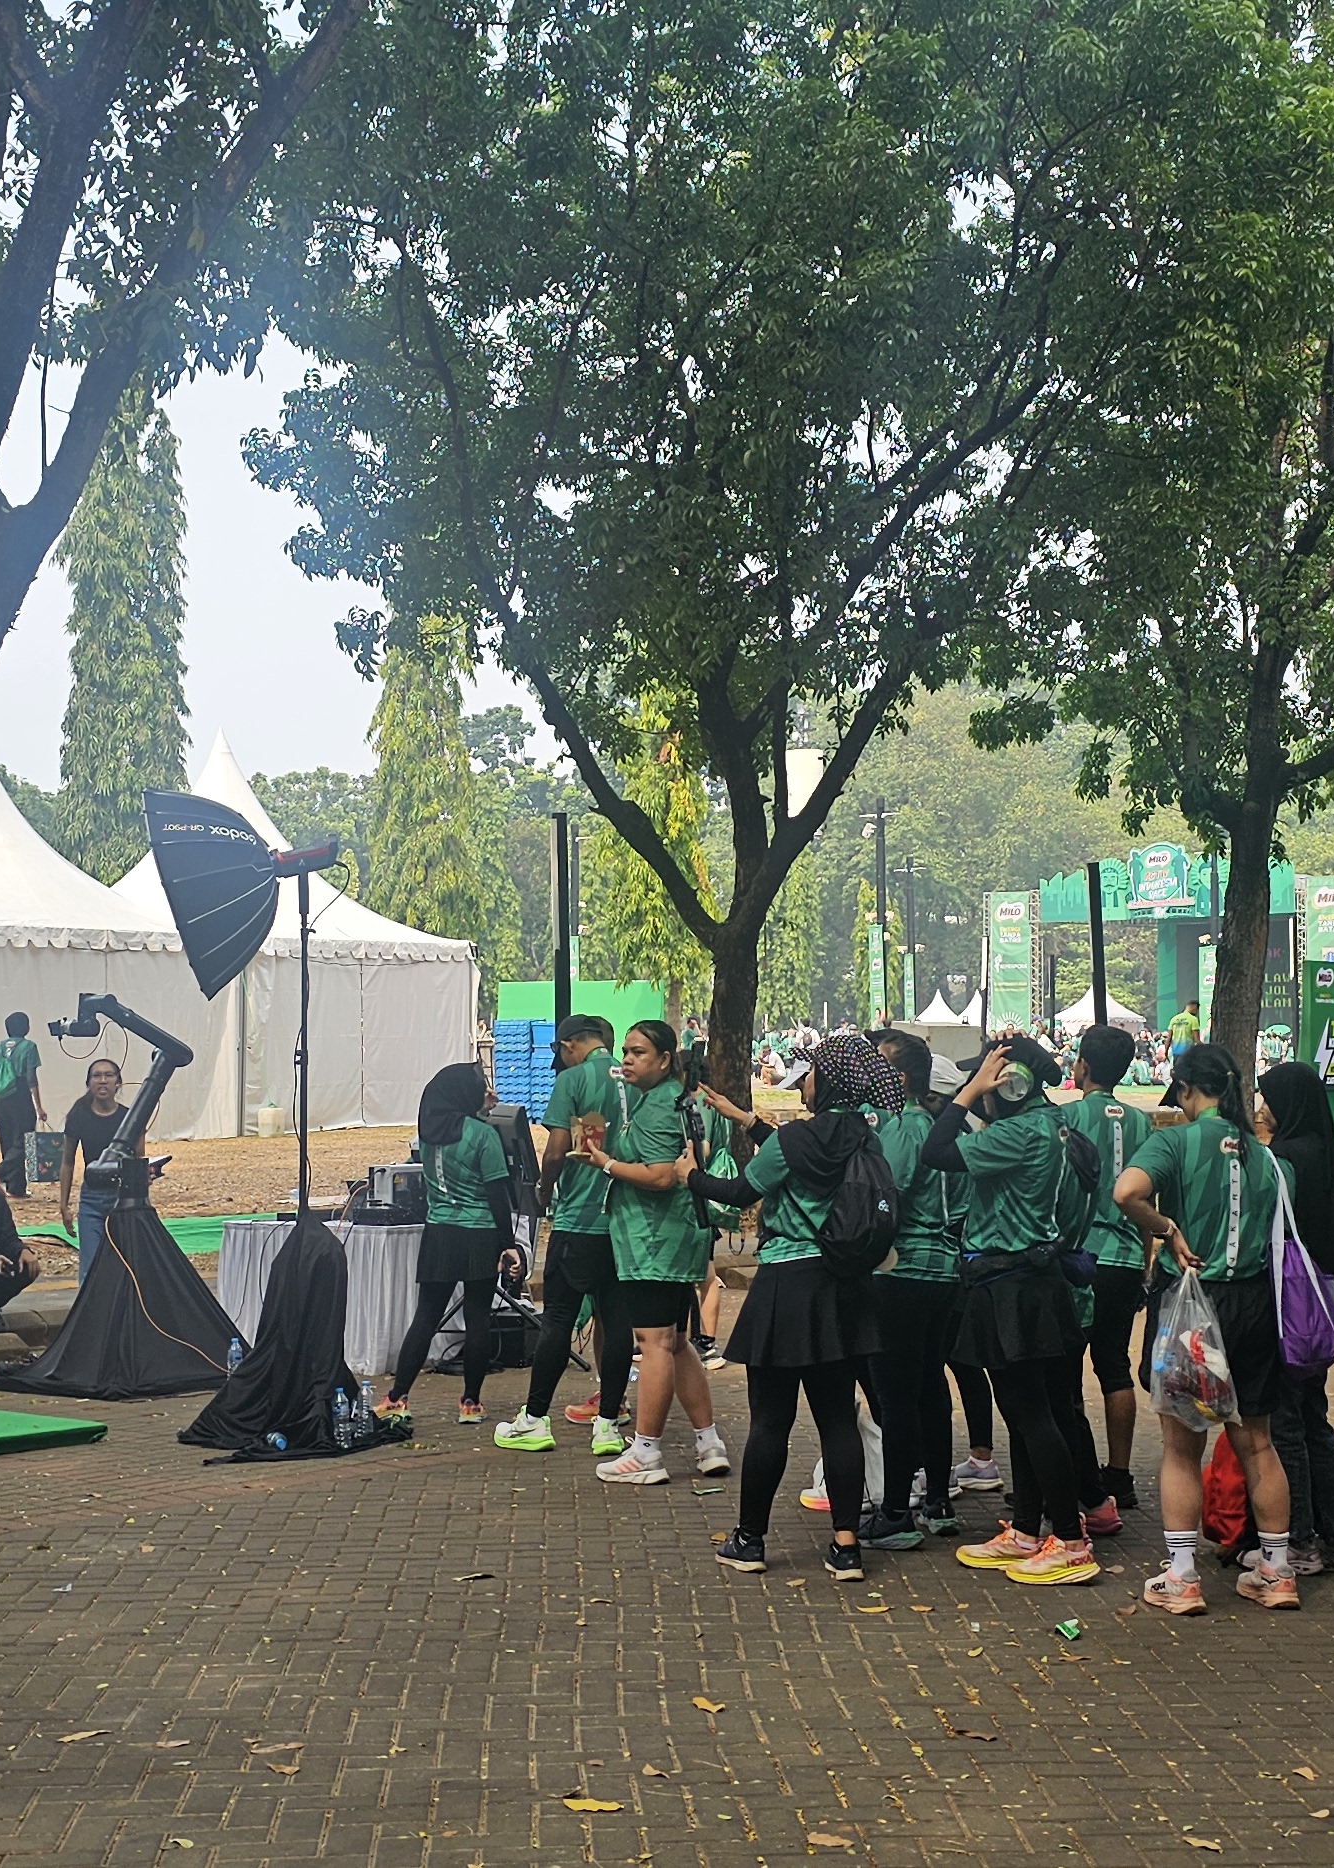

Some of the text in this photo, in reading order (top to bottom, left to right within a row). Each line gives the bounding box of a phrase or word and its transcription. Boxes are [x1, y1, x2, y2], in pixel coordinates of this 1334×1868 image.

[208, 825, 257, 846] Godox
[1148, 855, 1168, 864] MILO
[999, 907, 1021, 917] MILO
[1067, 1554, 1093, 1568] HOKA
